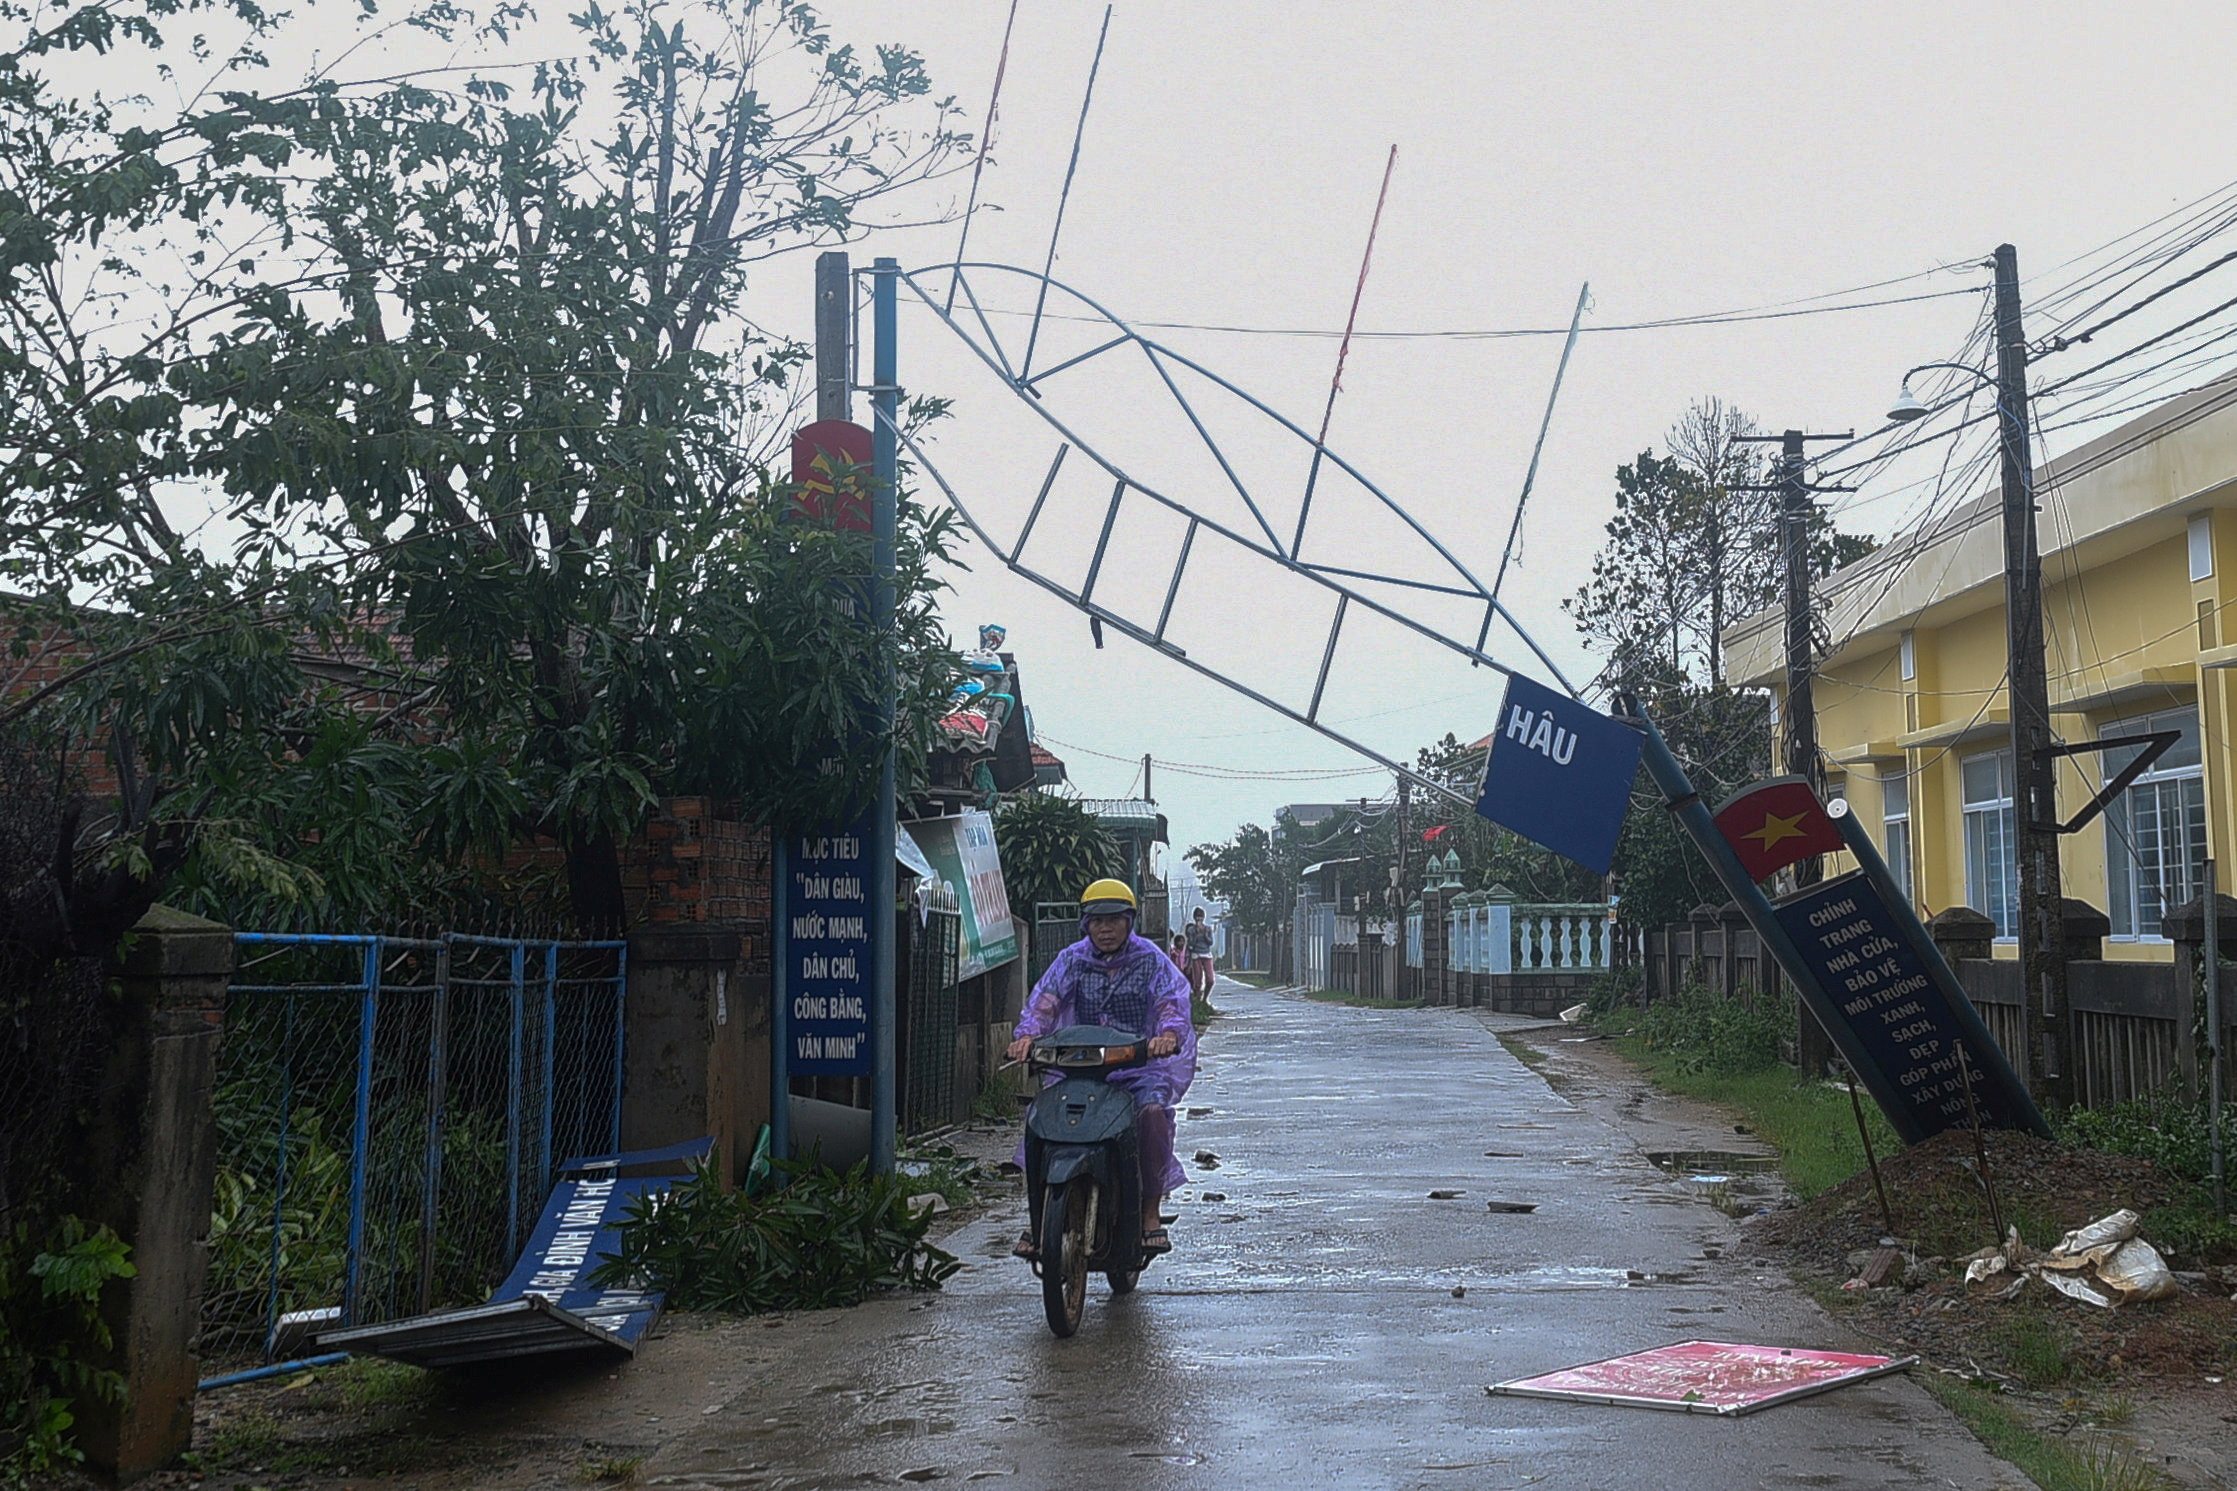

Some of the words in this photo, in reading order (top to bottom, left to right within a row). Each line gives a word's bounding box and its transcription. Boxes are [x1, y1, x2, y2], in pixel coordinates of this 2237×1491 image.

[1506, 704, 1578, 766] HÂU
[832, 833, 860, 860] TIÊU
[833, 871, 865, 904] GIÀU,
[793, 910, 826, 940] NƯỚC
[828, 917, 868, 944] MẠNH,
[1808, 898, 1857, 929] CHỈNH
[1820, 918, 1873, 950] TRANG
[803, 952, 829, 979] DÂN
[831, 949, 860, 983] CHỦ,
[1826, 946, 1859, 975] NHÀ
[1861, 934, 1899, 960] CỬA,
[1844, 967, 1879, 994] BẢO
[1880, 957, 1902, 978] VỆ
[794, 992, 827, 1020] CÔNG
[830, 988, 867, 1024] BẰNG,
[1844, 993, 1874, 1017] MÔI
[1872, 974, 1928, 1004] TRƯỜNG
[1880, 1002, 1926, 1025] XANH,
[797, 1032, 822, 1060] VĂN
[1891, 1020, 1937, 1044] SẠCH,
[1908, 1039, 1940, 1061] ĐẸP
[1899, 1064, 1929, 1087] GÓP
[1911, 1083, 1941, 1105] XÂY
[555, 1199, 608, 1229] VĂN
[535, 1230, 595, 1266] ĐÌNH
